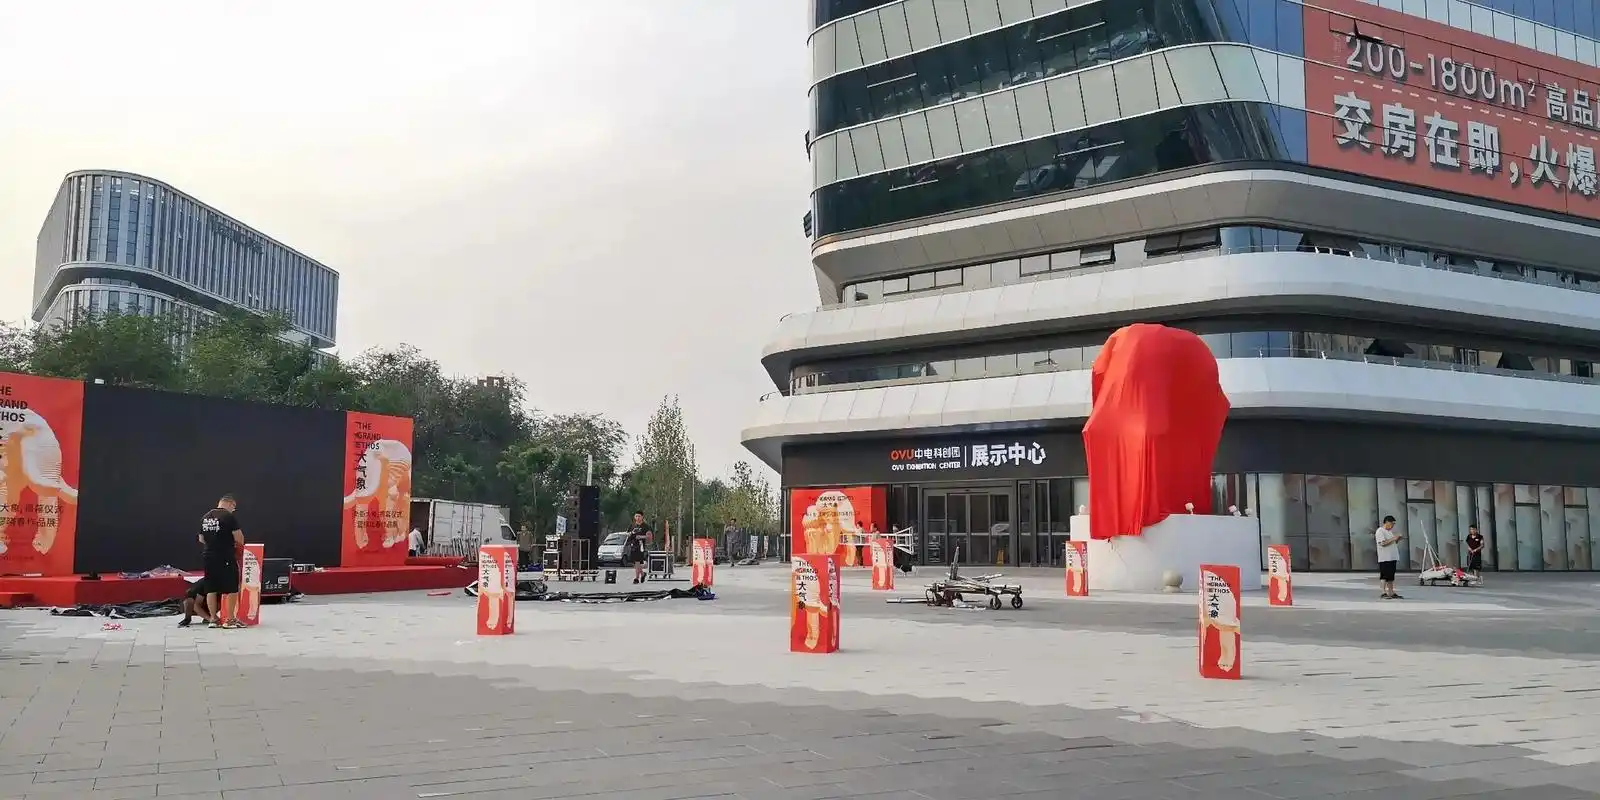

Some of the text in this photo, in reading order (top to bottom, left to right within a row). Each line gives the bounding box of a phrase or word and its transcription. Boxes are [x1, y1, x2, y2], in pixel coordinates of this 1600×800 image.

[1545, 82, 1600, 129] 高品
[939, 461, 961, 469] CENTER
[971, 442, 1047, 467] 展示中心
[1209, 593, 1219, 618] 大气象
